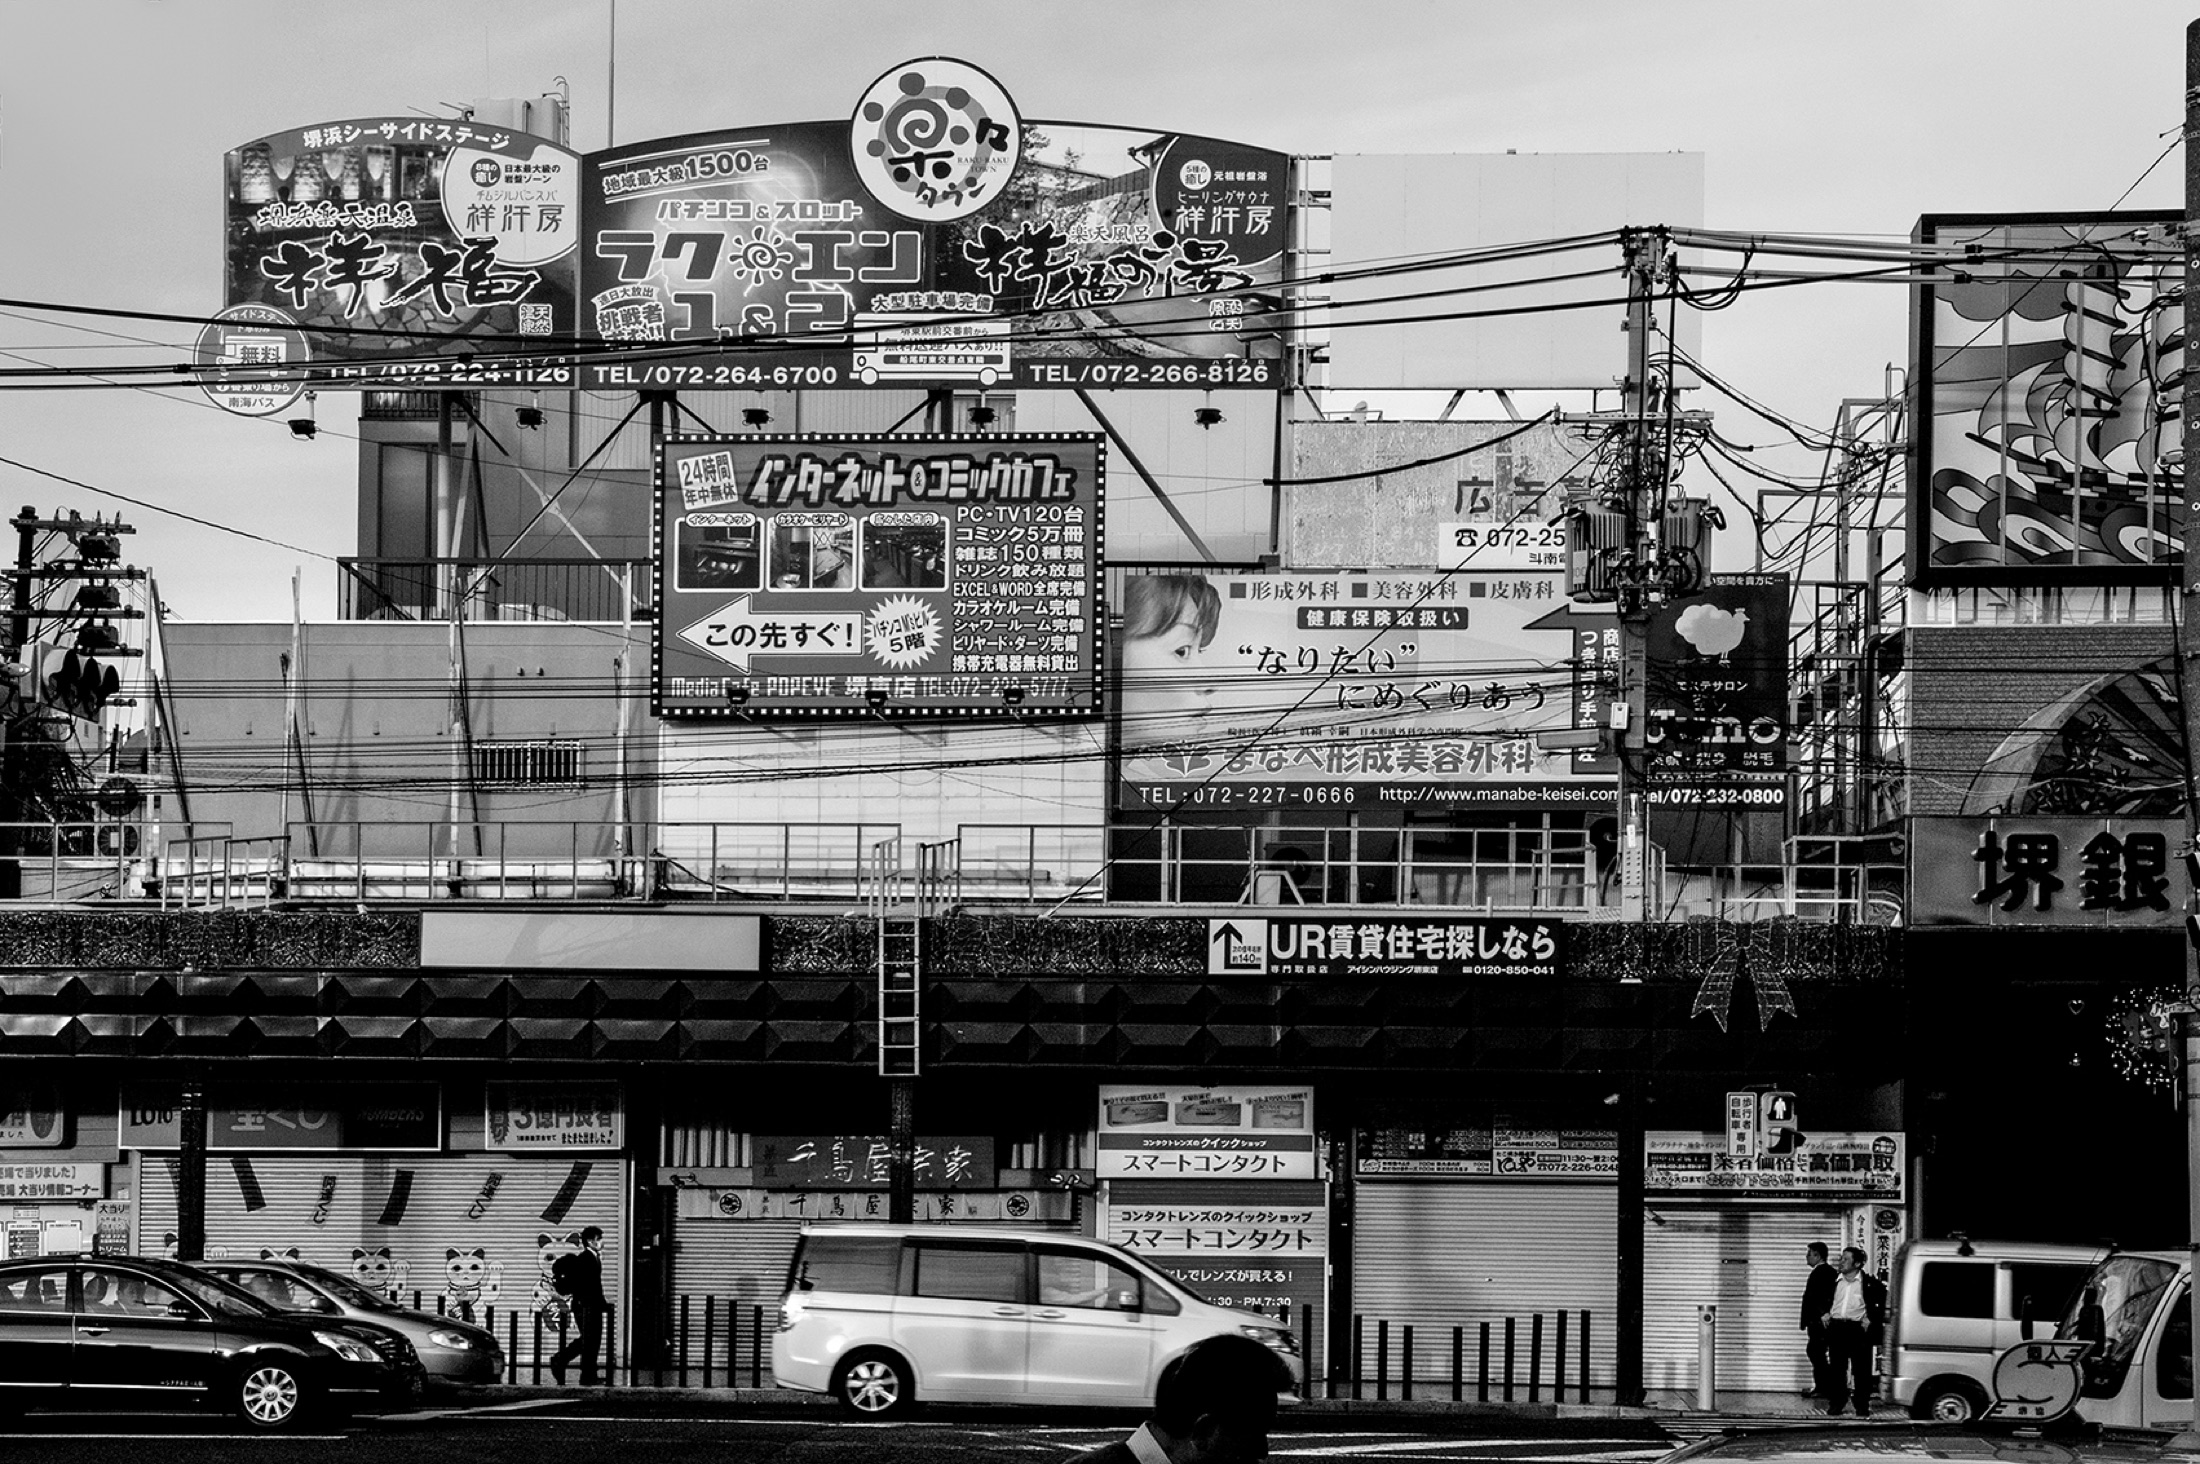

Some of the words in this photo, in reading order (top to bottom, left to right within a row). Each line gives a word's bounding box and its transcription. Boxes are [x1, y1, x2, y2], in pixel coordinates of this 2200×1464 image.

[303, 121, 510, 149] 堺浜シーサイドステージ
[504, 164, 561, 173] 日本最大級の
[602, 150, 770, 194] 地域最大級1500台
[1213, 171, 1268, 181] 元祖岩盤浴
[1178, 190, 1270, 204] ヒーリングサウナ
[466, 203, 566, 233] 祥汗房
[1174, 205, 1275, 235] 祥汗房
[871, 291, 994, 313] 大型駐車場完備
[241, 345, 281, 364] 無料
[592, 366, 838, 384] TEL/072-264-6700
[1030, 364, 1269, 383] TEL/072-266-8126
[228, 397, 276, 408] 南海バス
[681, 454, 732, 487] 24時間
[685, 482, 737, 506] 年中無休
[955, 526, 1085, 543] コミック5万冊
[955, 544, 1085, 562] 雑誌150種類
[955, 564, 1086, 578] ドリンク飲み放題
[1250, 581, 1341, 600] 形成外科
[1372, 581, 1459, 600] 美容外科
[1490, 580, 1556, 600] 皮膚科
[953, 600, 1081, 617] カラオケルーム完備
[953, 618, 1085, 633] シャワールーム完備
[1306, 609, 1462, 628] 健康保険取扱い
[706, 621, 854, 649] この先すぐ!
[889, 631, 926, 654] 5階
[953, 635, 1079, 652] ビリヤード・ダーツ完備
[953, 654, 1079, 672] 携帯充電器無料貸出
[1336, 680, 1547, 712] にめぐりあう
[1139, 786, 1356, 805] TEL:072-227-0666
[1270, 923, 1556, 961] UR賃貸住宅探しなら
[1271, 965, 1329, 974] 専門取扱店
[1474, 965, 1556, 975] 0120-850-041
[1122, 1153, 1287, 1173] スマートコンタクト
[1121, 1210, 1314, 1224] コンタクトレンズのクイックショップ
[1120, 1228, 1314, 1251] スマートコンタクト
